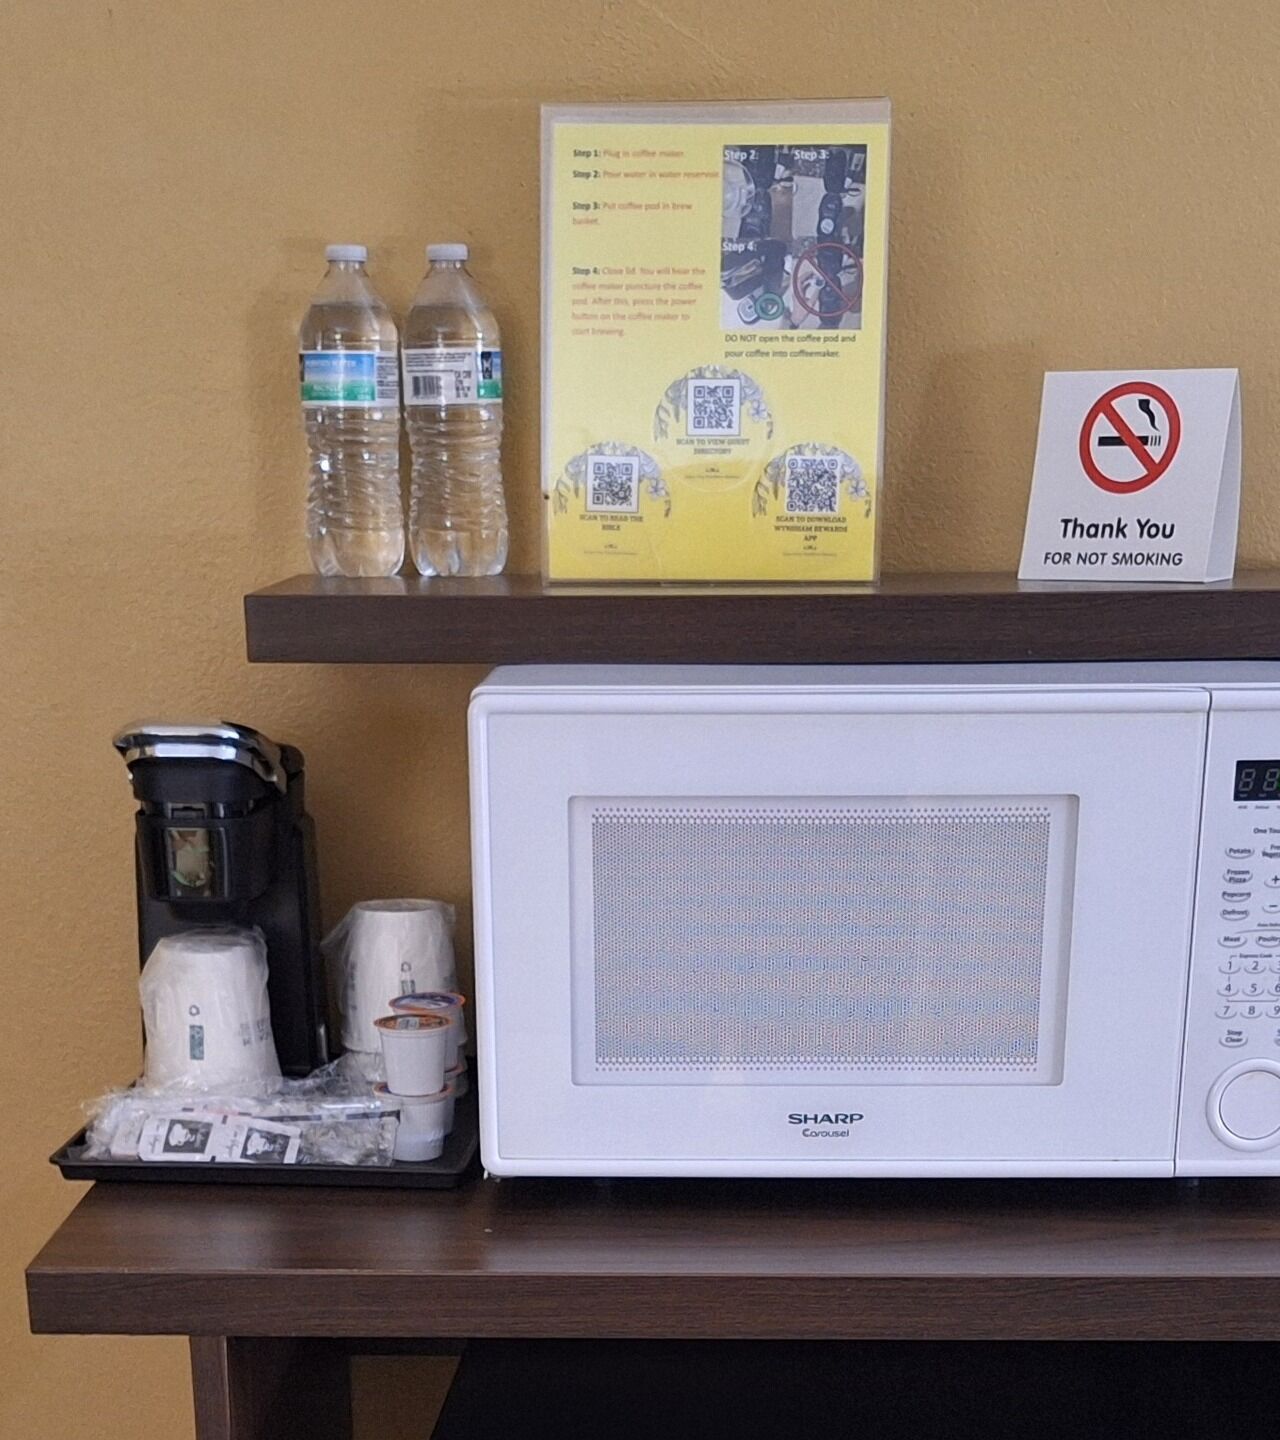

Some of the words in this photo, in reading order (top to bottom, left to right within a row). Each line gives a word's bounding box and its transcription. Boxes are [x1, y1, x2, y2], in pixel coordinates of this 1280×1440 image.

[573, 149, 591, 159] Step
[593, 149, 600, 157] 1:
[603, 149, 620, 159] Plug
[631, 149, 656, 157] coffee
[724, 150, 747, 162] Step
[749, 150, 759, 160] 2:
[793, 149, 817, 161] Step
[818, 149, 830, 159] 3:
[572, 170, 591, 179] Step
[593, 170, 600, 178] 2:
[603, 170, 621, 178] Pour
[623, 170, 646, 178] water
[658, 170, 681, 178] water
[572, 201, 591, 211] Step
[593, 201, 600, 210] 3:
[603, 202, 616, 210] Put
[618, 202, 642, 210] coffee
[644, 202, 660, 211] pod
[672, 202, 693, 210] brew
[722, 241, 745, 253] Step
[747, 241, 757, 251] 4:
[572, 267, 591, 276] Step
[592, 267, 600, 275] 4:
[602, 267, 623, 275] Close
[671, 266, 690, 275] hear
[692, 267, 706, 275] the
[572, 283, 596, 291] coffee
[598, 283, 623, 291] maker
[625, 283, 660, 291] puncture
[662, 283, 676, 291] the
[678, 283, 703, 291] coffee
[655, 298, 668, 306] the
[670, 298, 696, 306] power
[572, 313, 598, 321] button
[600, 313, 611, 321] on
[612, 313, 626, 321] the
[627, 313, 652, 321] coffee
[654, 313, 679, 321] maker
[724, 334, 738, 342] DO
[740, 334, 757, 342] NOT
[758, 335, 780, 344] open
[781, 334, 795, 342] the
[796, 334, 821, 342] coffee
[823, 335, 839, 344] pod
[724, 351, 744, 359] pour
[745, 349, 770, 358] coffee
[772, 350, 788, 358] into
[1060, 517, 1128, 540] Thank
[1136, 518, 1176, 540] You
[1043, 552, 1072, 566] FOR
[1076, 552, 1108, 566] NOT
[1111, 552, 1184, 566] SMOKING
[1228, 847, 1251, 855] Potato
[1222, 890, 1251, 898] Popcorn
[1227, 961, 1232, 970] 1
[1252, 961, 1259, 970] 2
[1225, 983, 1232, 993] 4
[1250, 983, 1257, 993] 5
[1223, 1005, 1230, 1015] 7
[1248, 1005, 1256, 1015] 8
[1273, 1005, 1280, 1015] 9
[788, 1113, 864, 1125] SHARP
[802, 1128, 850, 1138] Carousel
